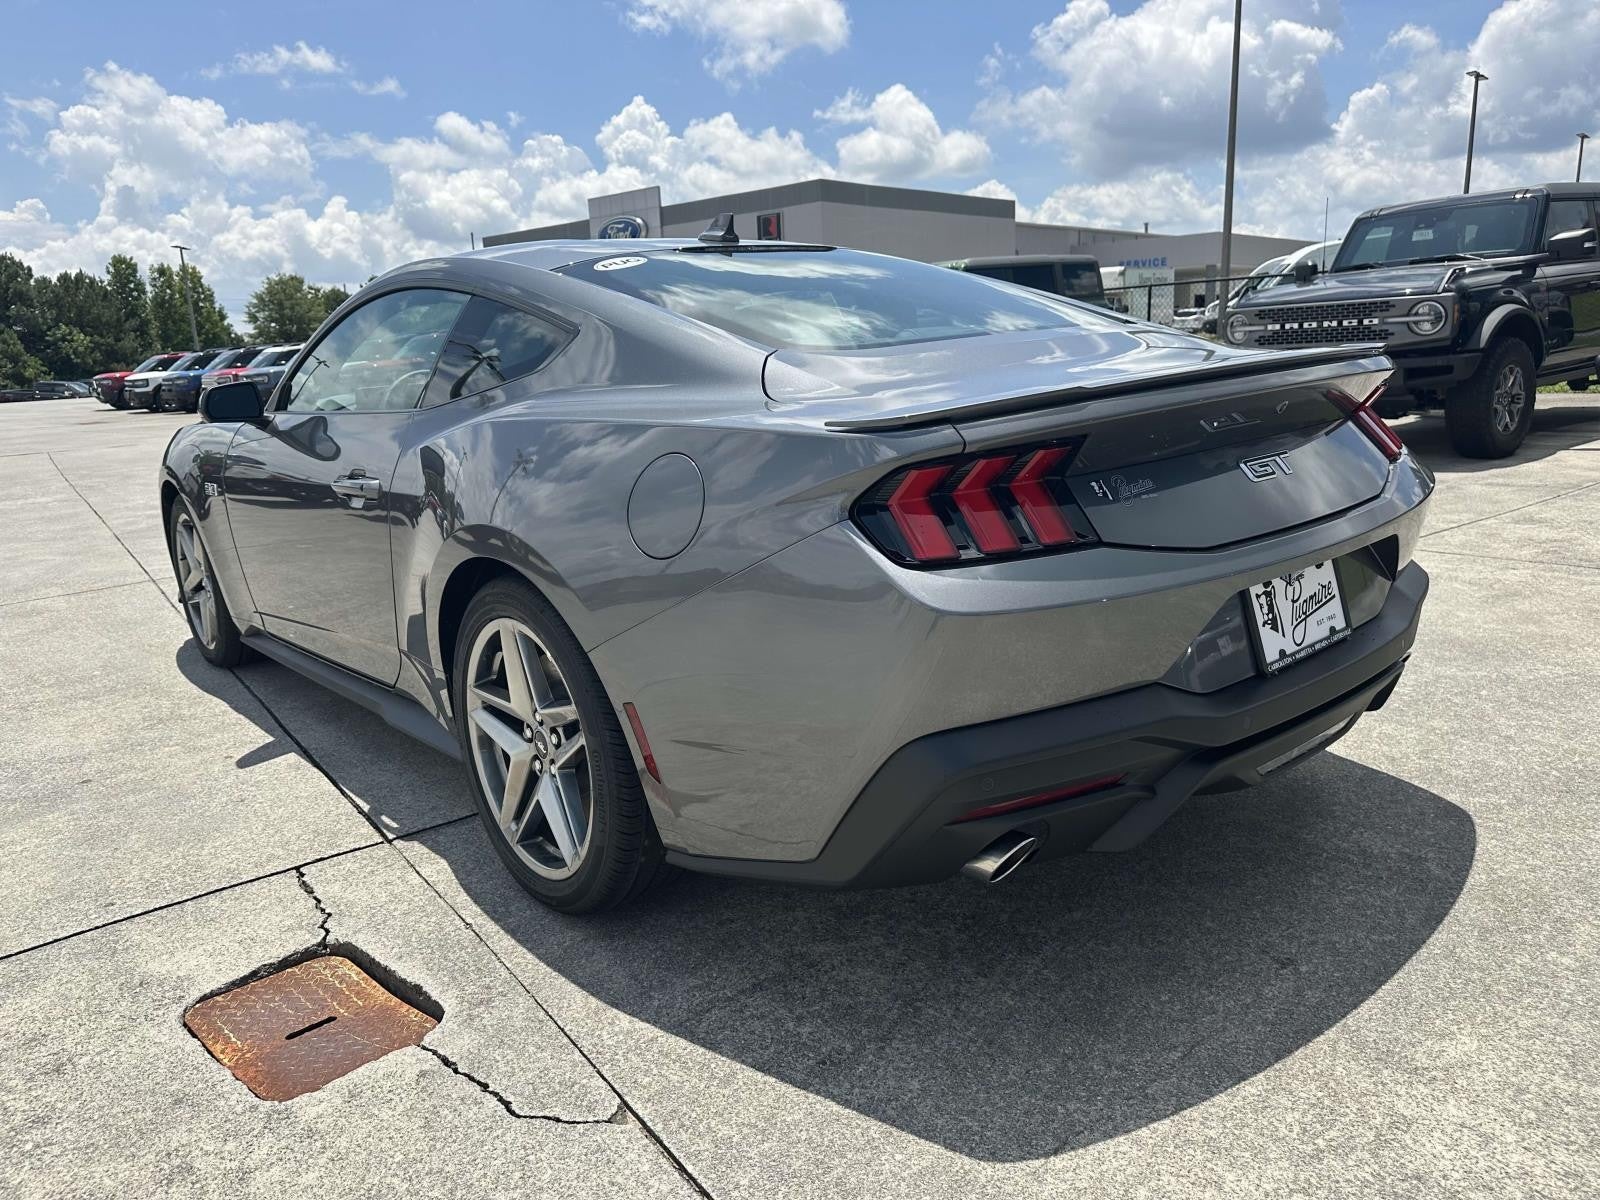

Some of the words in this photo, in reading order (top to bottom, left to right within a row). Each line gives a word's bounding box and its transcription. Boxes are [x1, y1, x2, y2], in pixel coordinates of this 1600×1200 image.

[607, 223, 631, 239] Ford
[1267, 318, 1379, 330] BRONCO
[1240, 449, 1293, 482] GT
[1284, 576, 1336, 647] Pugmire
